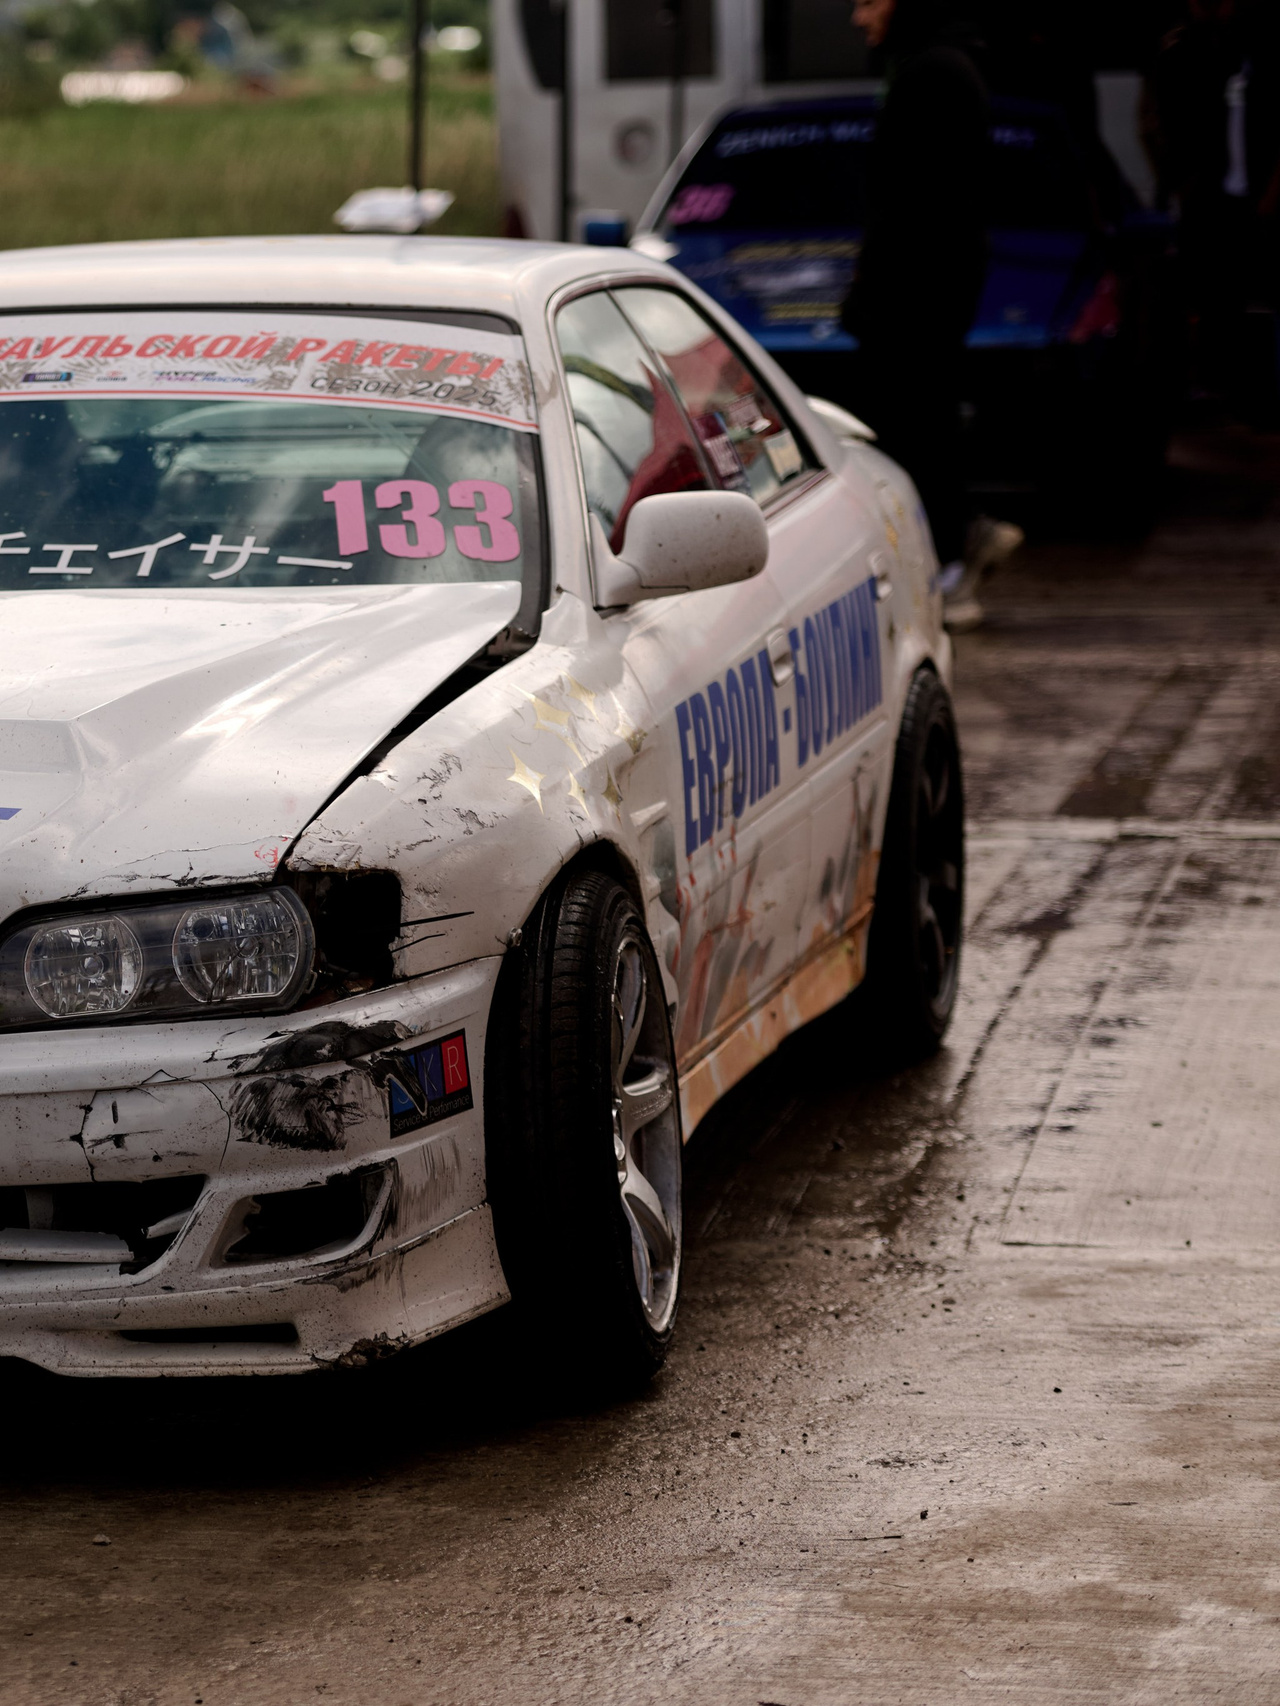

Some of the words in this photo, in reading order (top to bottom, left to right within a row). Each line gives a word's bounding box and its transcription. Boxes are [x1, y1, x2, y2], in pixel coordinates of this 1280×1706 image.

[287, 338, 505, 380] РАКЕТЫ
[310, 376, 402, 395] СЕЗОН
[410, 380, 502, 406] 2025
[322, 479, 521, 562] 133
